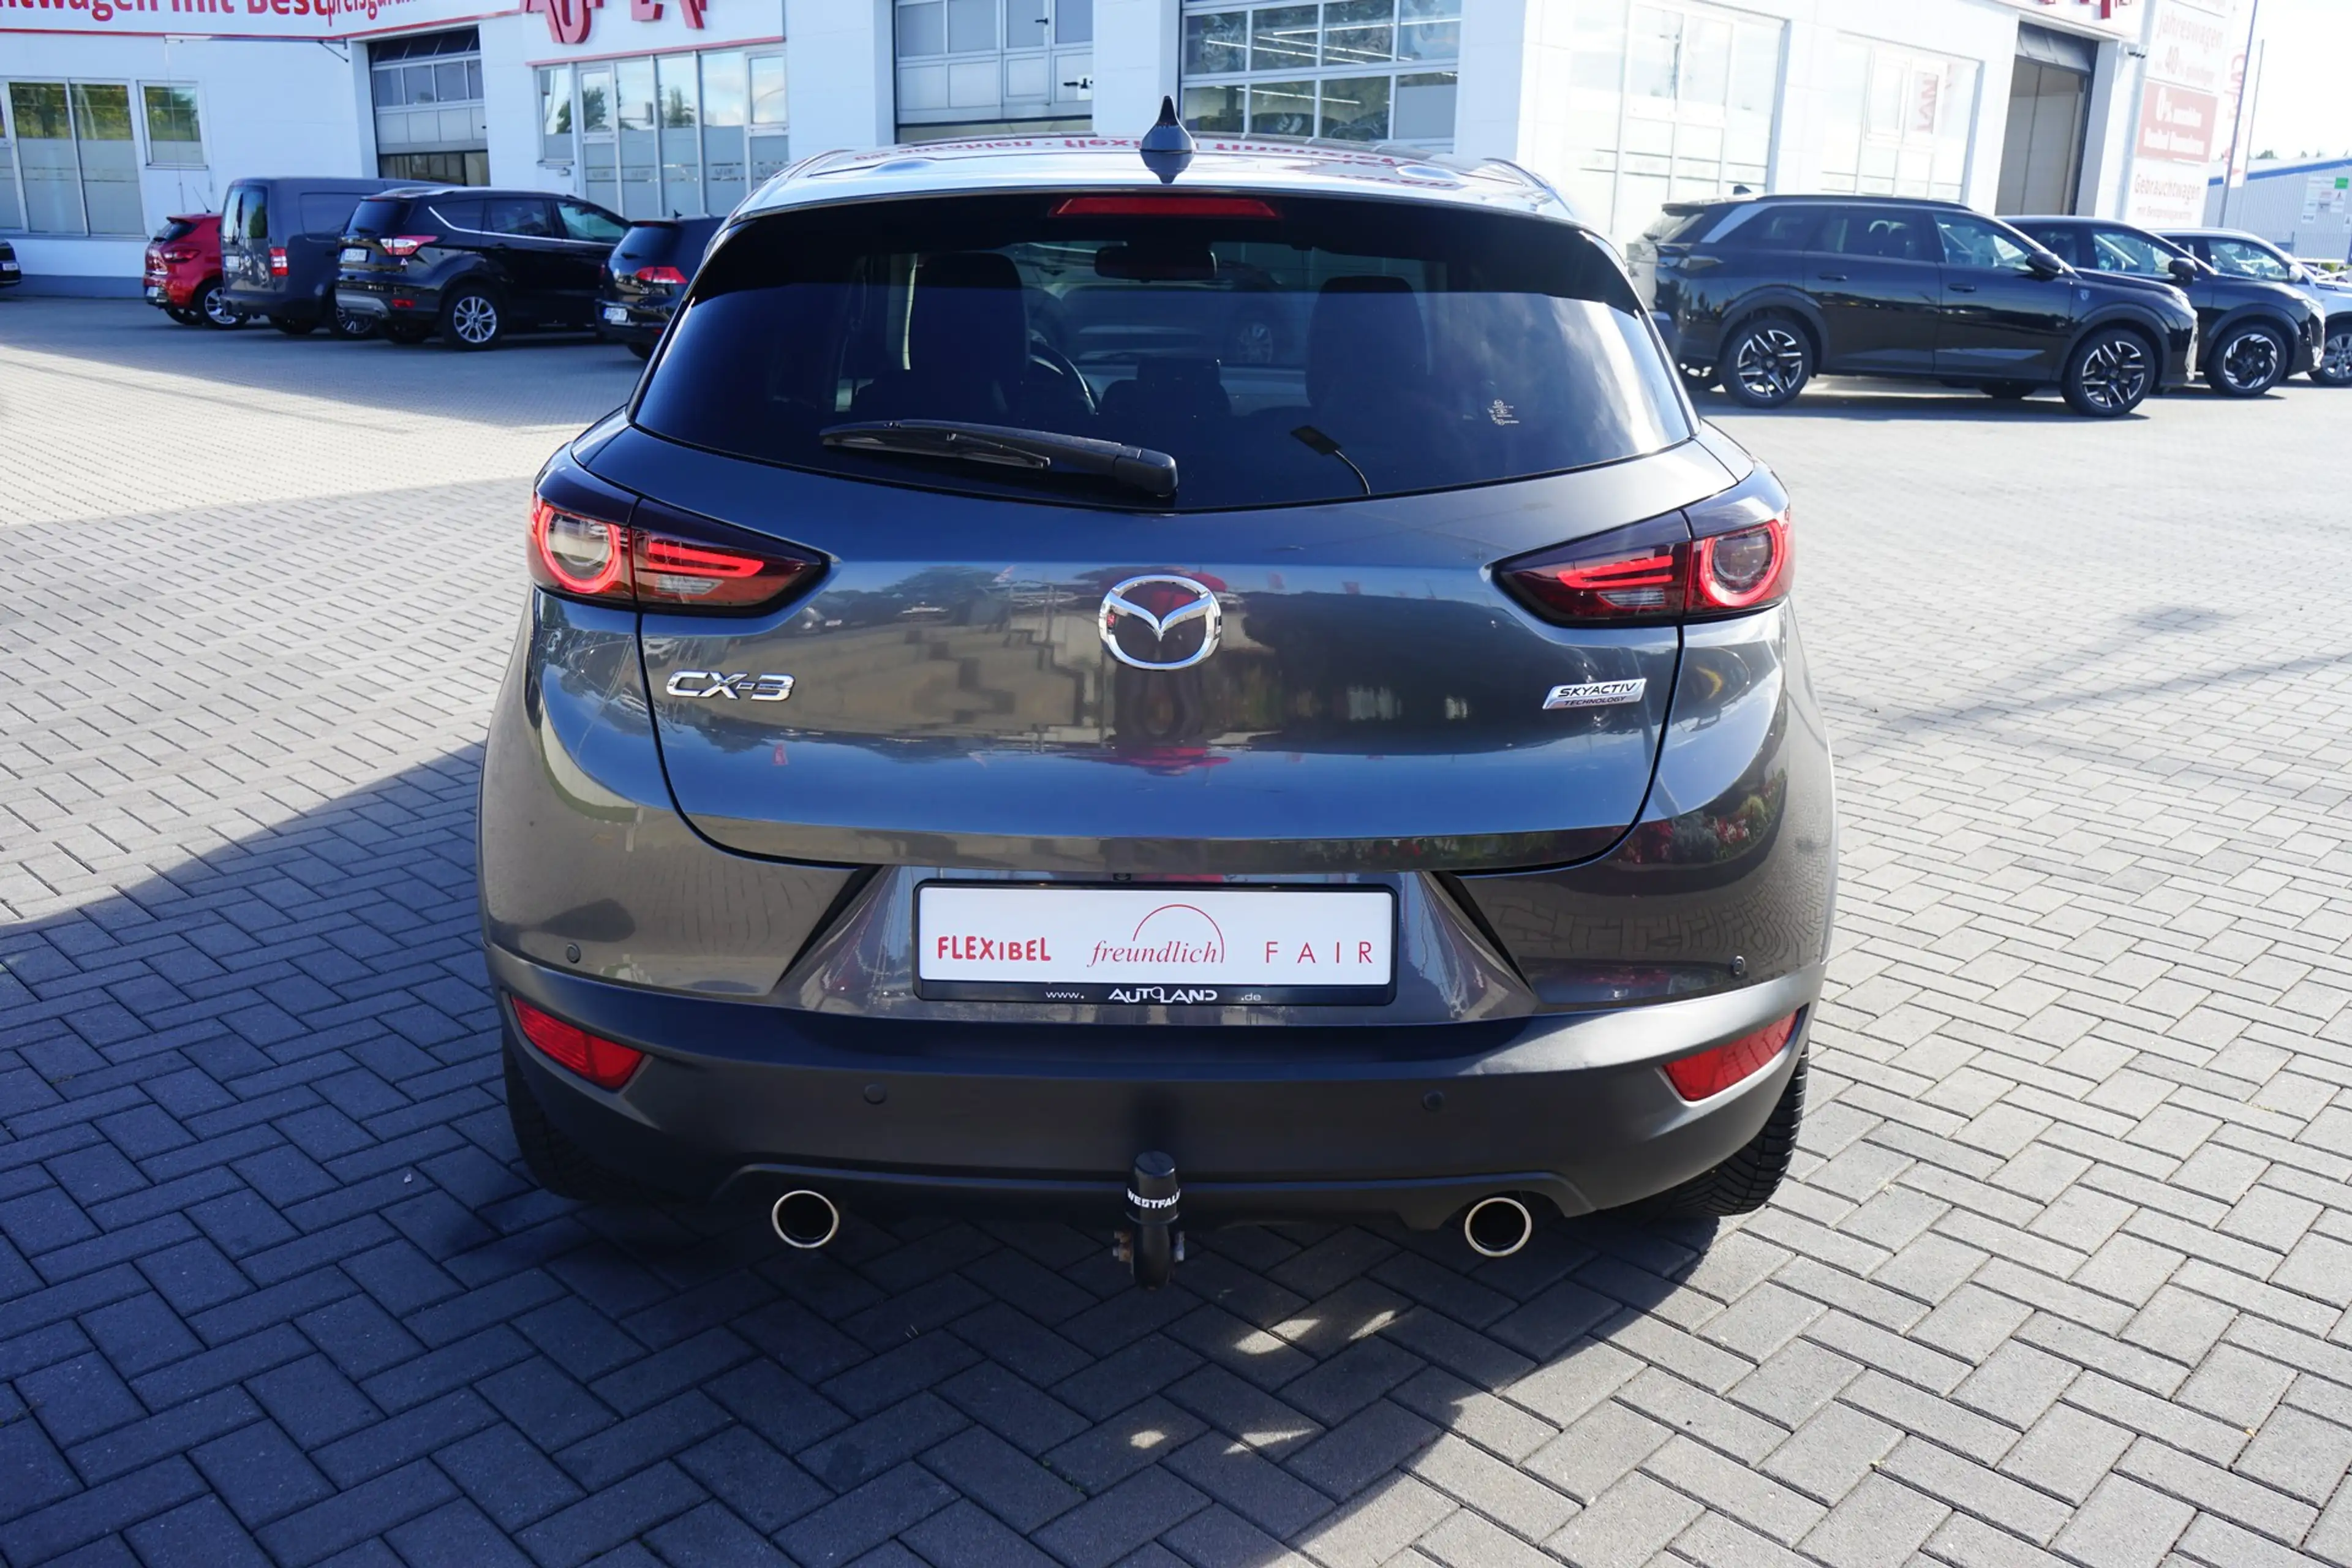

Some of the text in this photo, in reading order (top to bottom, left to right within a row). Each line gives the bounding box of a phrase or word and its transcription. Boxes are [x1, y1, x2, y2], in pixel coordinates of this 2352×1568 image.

[666, 670, 796, 701] CX-3
[1558, 682, 1637, 698] SKYACTIV
[1564, 695, 1627, 706] TECHNOLOGY
[938, 936, 1374, 967] FLEXIBEL freundlich FAIR
[1107, 986, 1218, 1005] AUTOLAND
[1240, 992, 1262, 1002] .de
